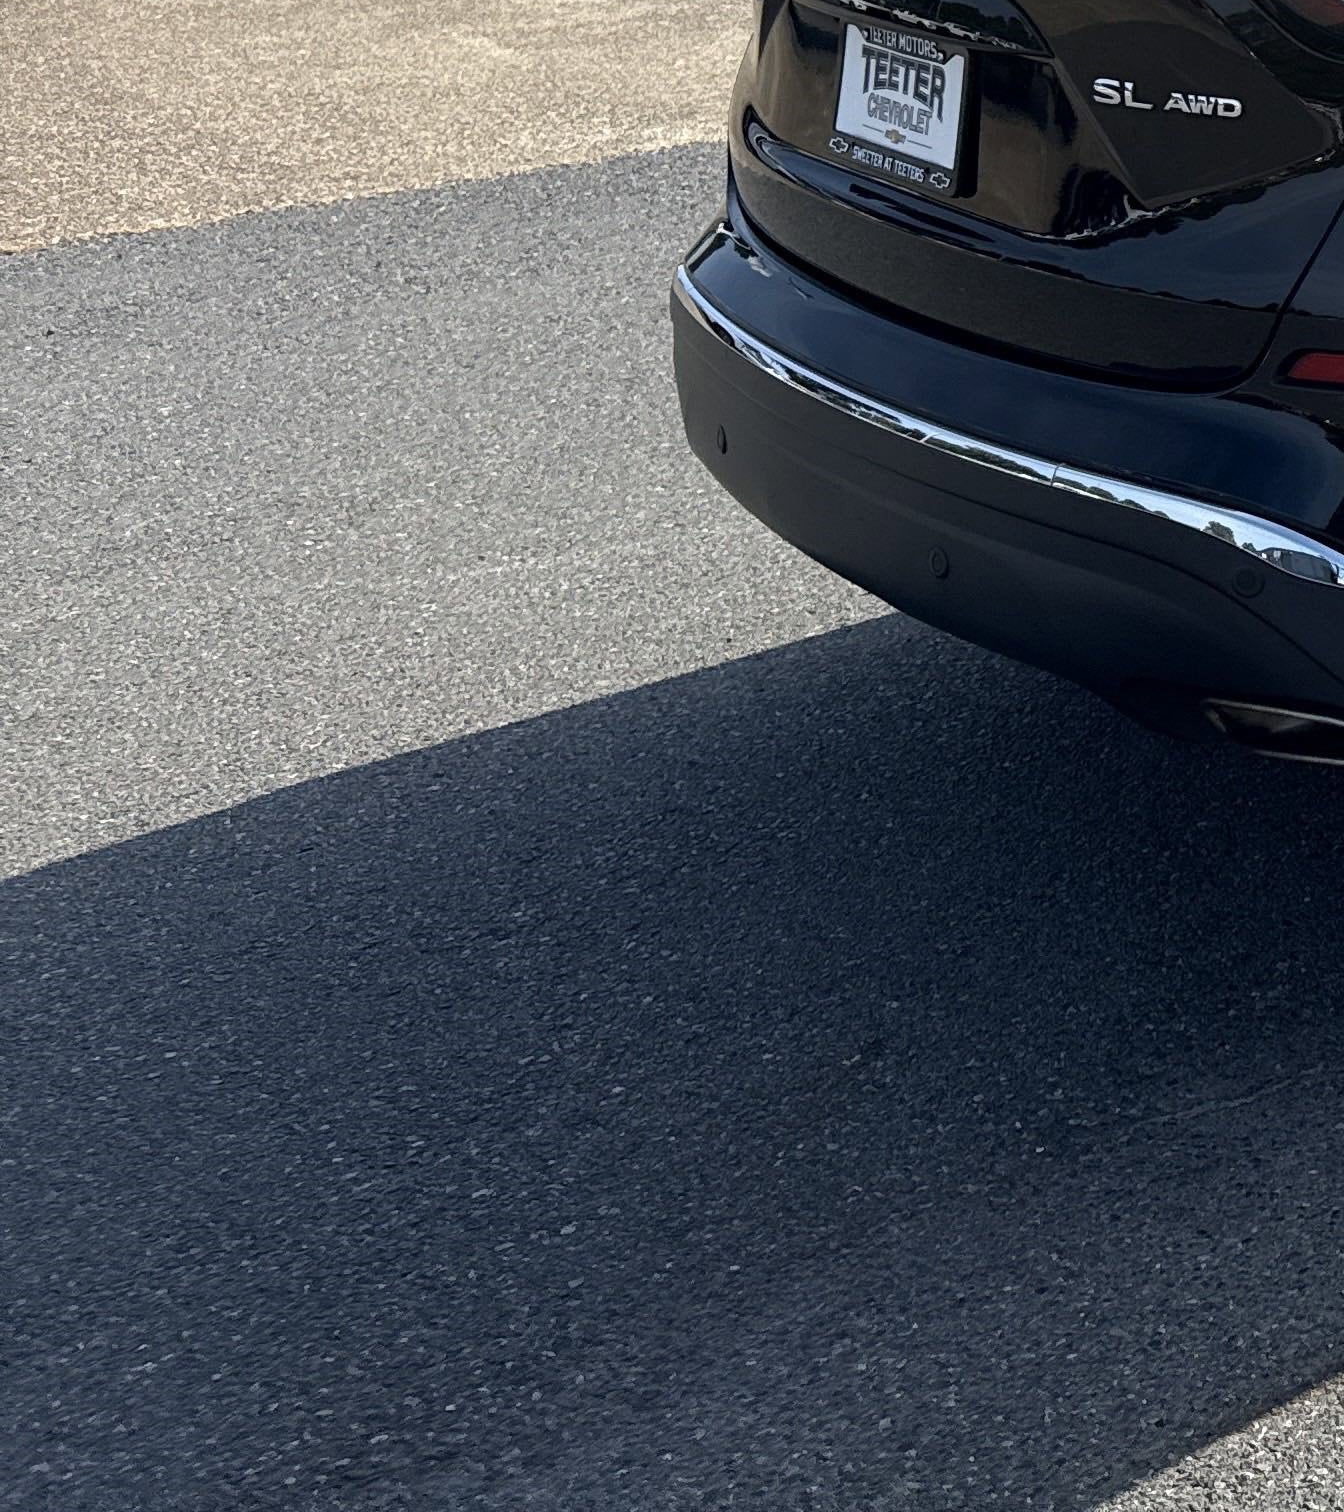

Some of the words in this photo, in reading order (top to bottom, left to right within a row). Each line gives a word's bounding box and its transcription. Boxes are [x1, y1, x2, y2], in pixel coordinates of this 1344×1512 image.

[869, 26, 898, 48] TEETER
[899, 34, 938, 58] MOTORS
[861, 44, 946, 124] TEETER
[1092, 77, 1154, 110] SL
[1163, 92, 1243, 118] AWD
[867, 92, 933, 136] CHEVROLET
[851, 146, 884, 168] SWEETER
[884, 157, 894, 171] AT
[893, 159, 926, 183] TEETERS
